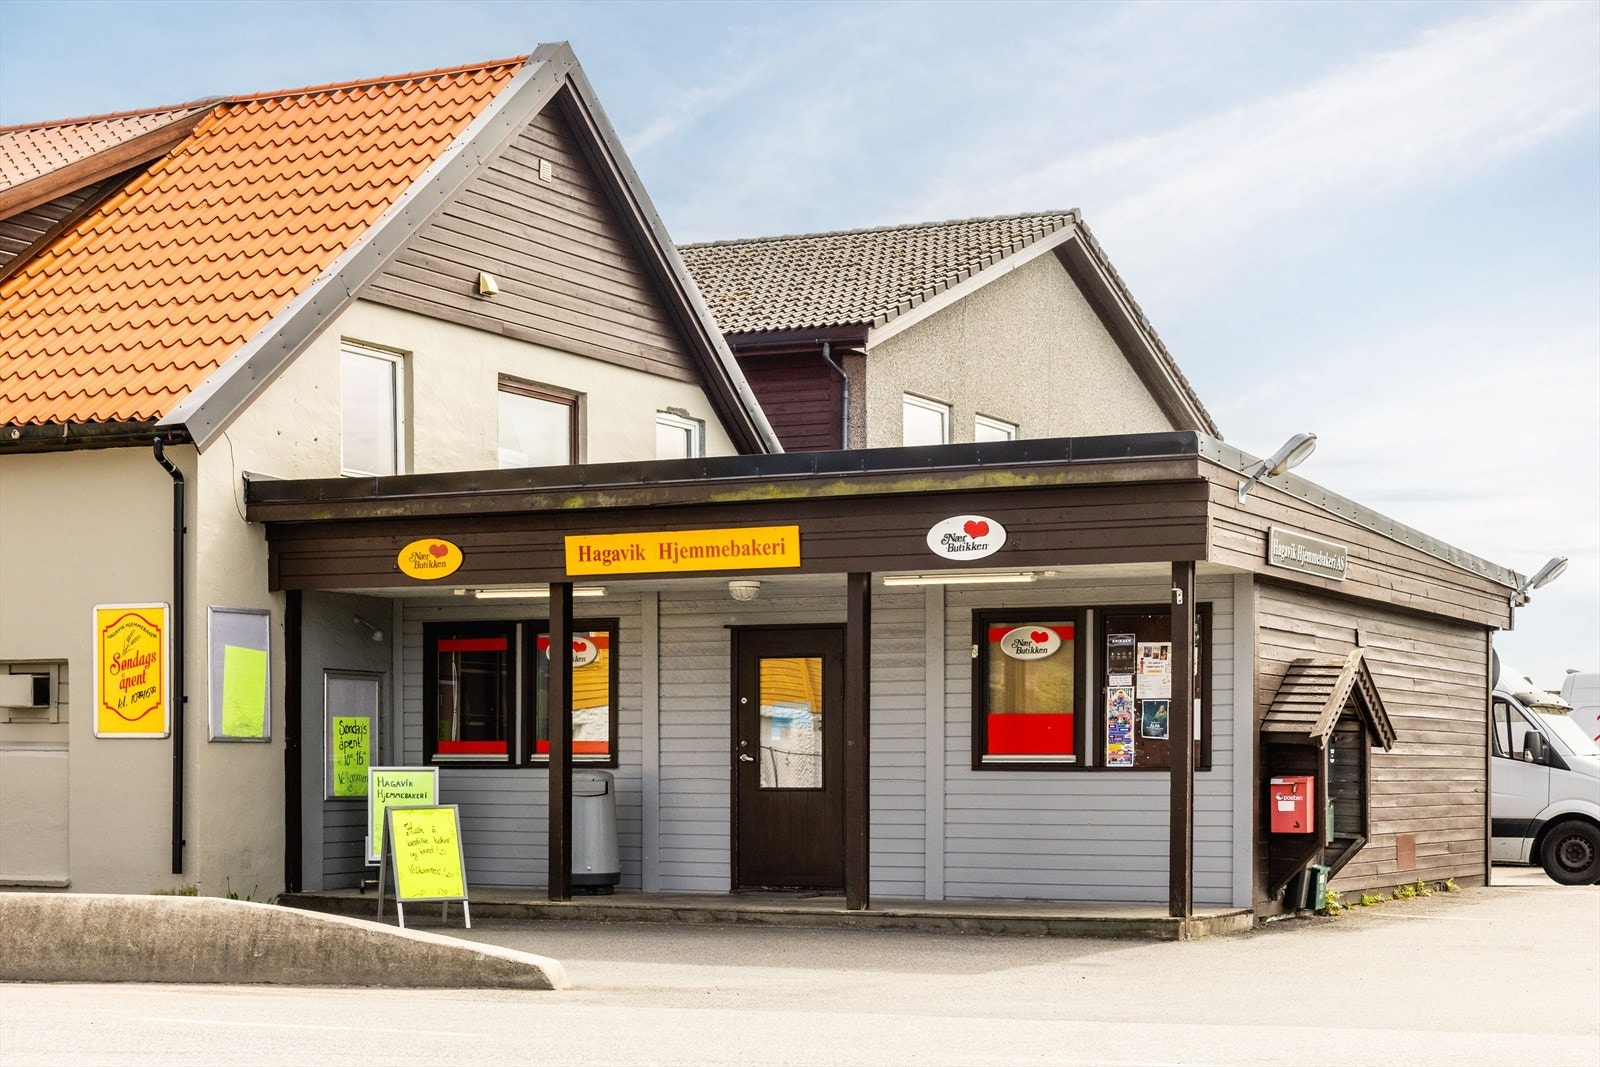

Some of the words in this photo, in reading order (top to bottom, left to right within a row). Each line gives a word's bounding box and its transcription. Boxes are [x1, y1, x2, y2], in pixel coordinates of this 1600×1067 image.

[941, 532, 967, 545] Nær
[578, 544, 646, 566] Hagavik
[658, 537, 786, 564] Hjemmebakeri
[947, 541, 988, 552] Butikken
[409, 552, 430, 562] Nær
[1274, 539, 1297, 560] Hagavik
[1298, 545, 1336, 568] Hjemmebakeri
[1336, 555, 1345, 571] AS
[413, 560, 447, 569] Butikken
[1011, 638, 1032, 649] Nær
[1015, 646, 1048, 654] Butikken
[110, 650, 157, 676] Søndags
[120, 669, 147, 693] åpent
[338, 737, 363, 754] åpent
